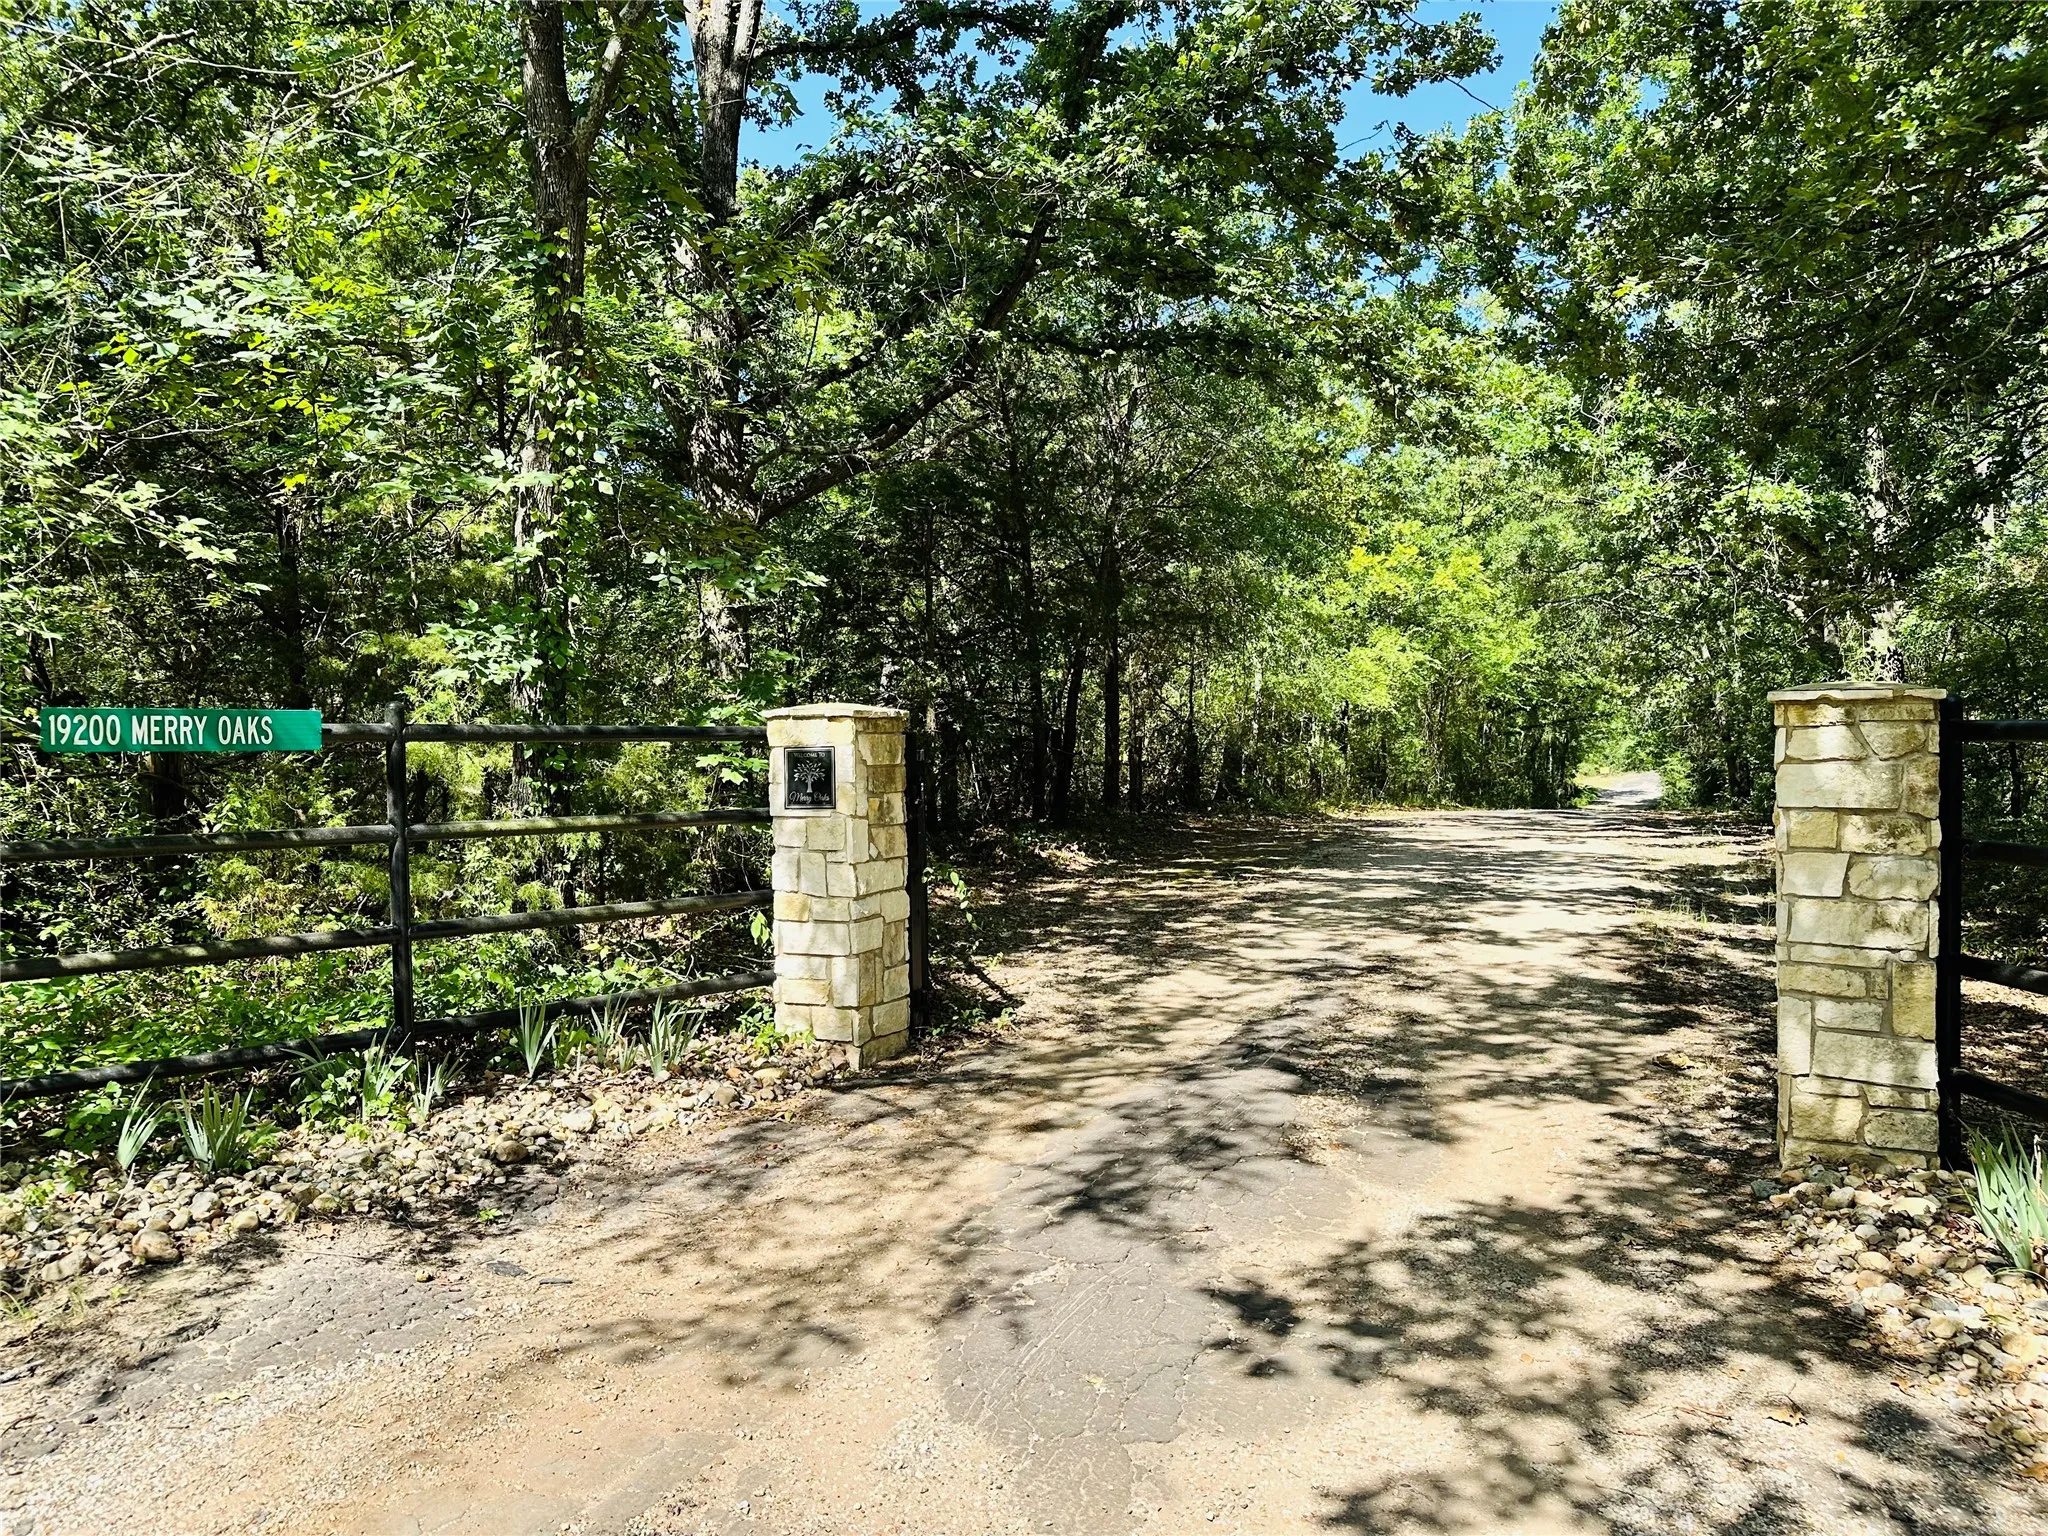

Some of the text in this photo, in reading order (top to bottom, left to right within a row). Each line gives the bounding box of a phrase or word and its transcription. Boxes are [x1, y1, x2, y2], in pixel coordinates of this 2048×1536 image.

[48, 714, 273, 745] 19200 MERRY OAKS
